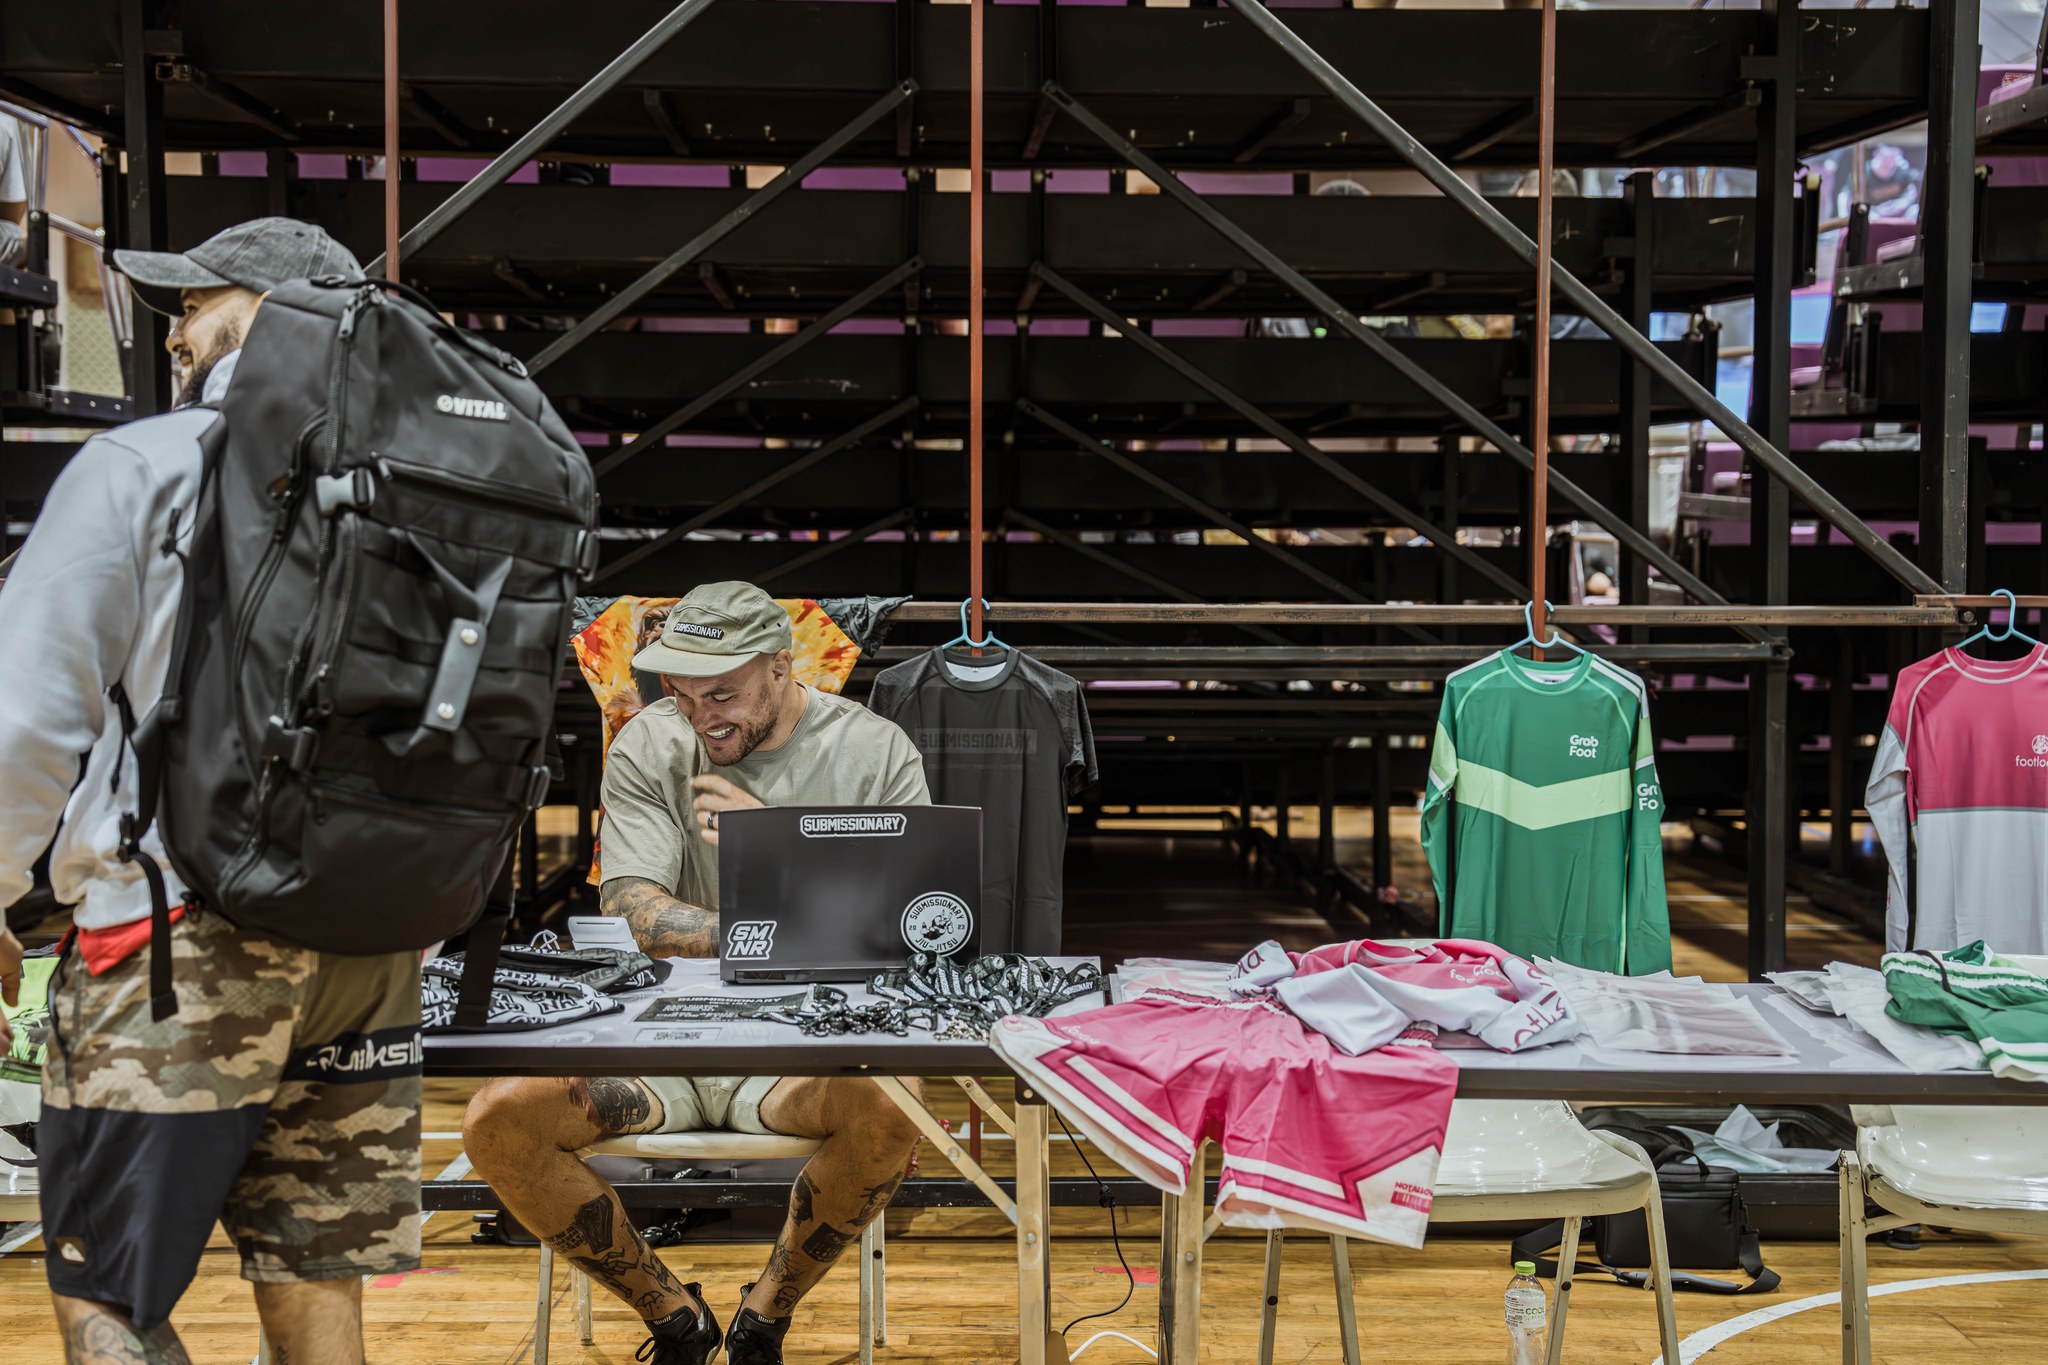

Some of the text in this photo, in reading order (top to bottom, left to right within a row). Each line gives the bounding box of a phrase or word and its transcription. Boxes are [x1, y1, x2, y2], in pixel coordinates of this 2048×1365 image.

[919, 732, 1032, 749] SUBMISSIONARY
[1569, 734, 1599, 747] Grab
[1569, 746, 1597, 758] Foot
[2015, 754, 2048, 768] footlo
[803, 816, 901, 832] SUBMISSIONARY
[910, 898, 965, 920] SUBMISSIONARY
[732, 925, 771, 941] SM
[732, 940, 768, 956] NR
[915, 937, 958, 951] JIU-JITSU
